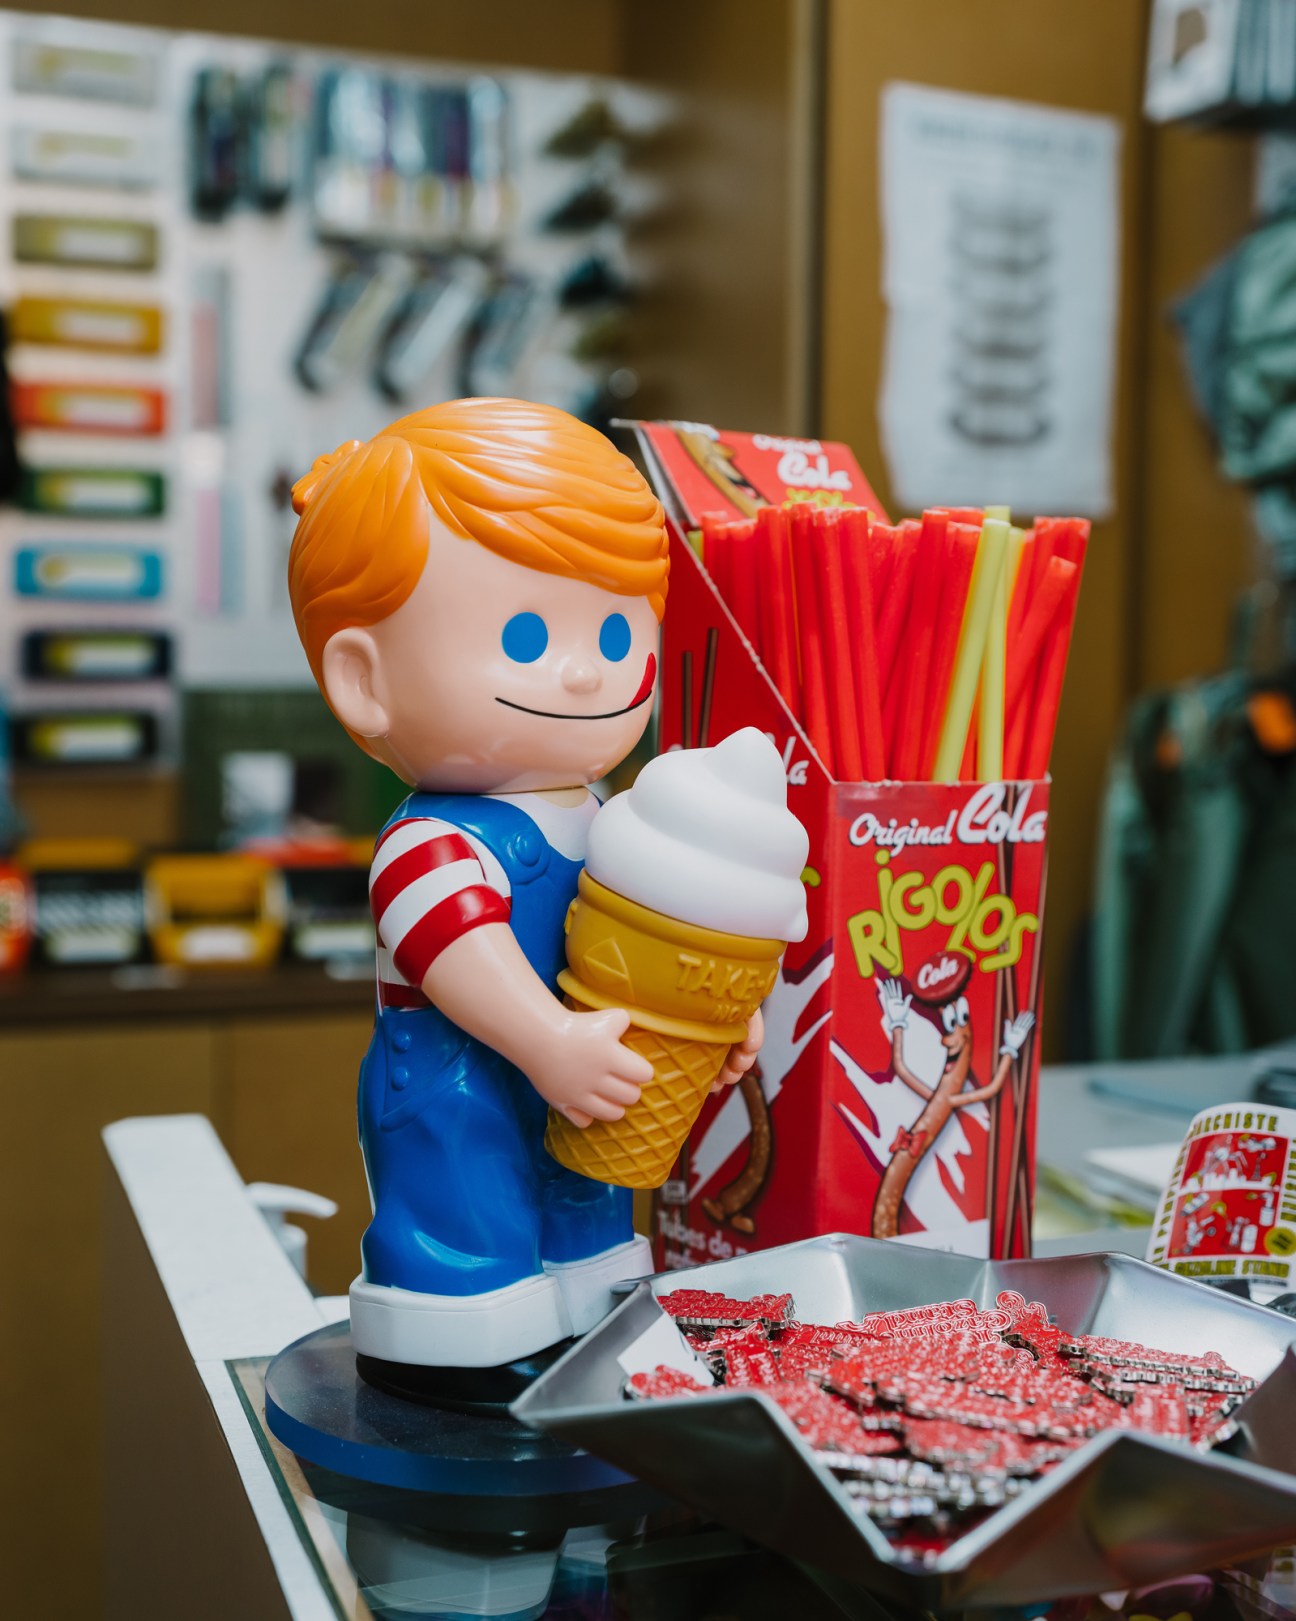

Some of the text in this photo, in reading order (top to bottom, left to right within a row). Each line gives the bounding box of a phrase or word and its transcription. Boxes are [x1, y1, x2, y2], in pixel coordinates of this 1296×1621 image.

[777, 450, 853, 491] Cola
[850, 783, 1047, 858] Original Cola
[917, 952, 958, 990] Cola
